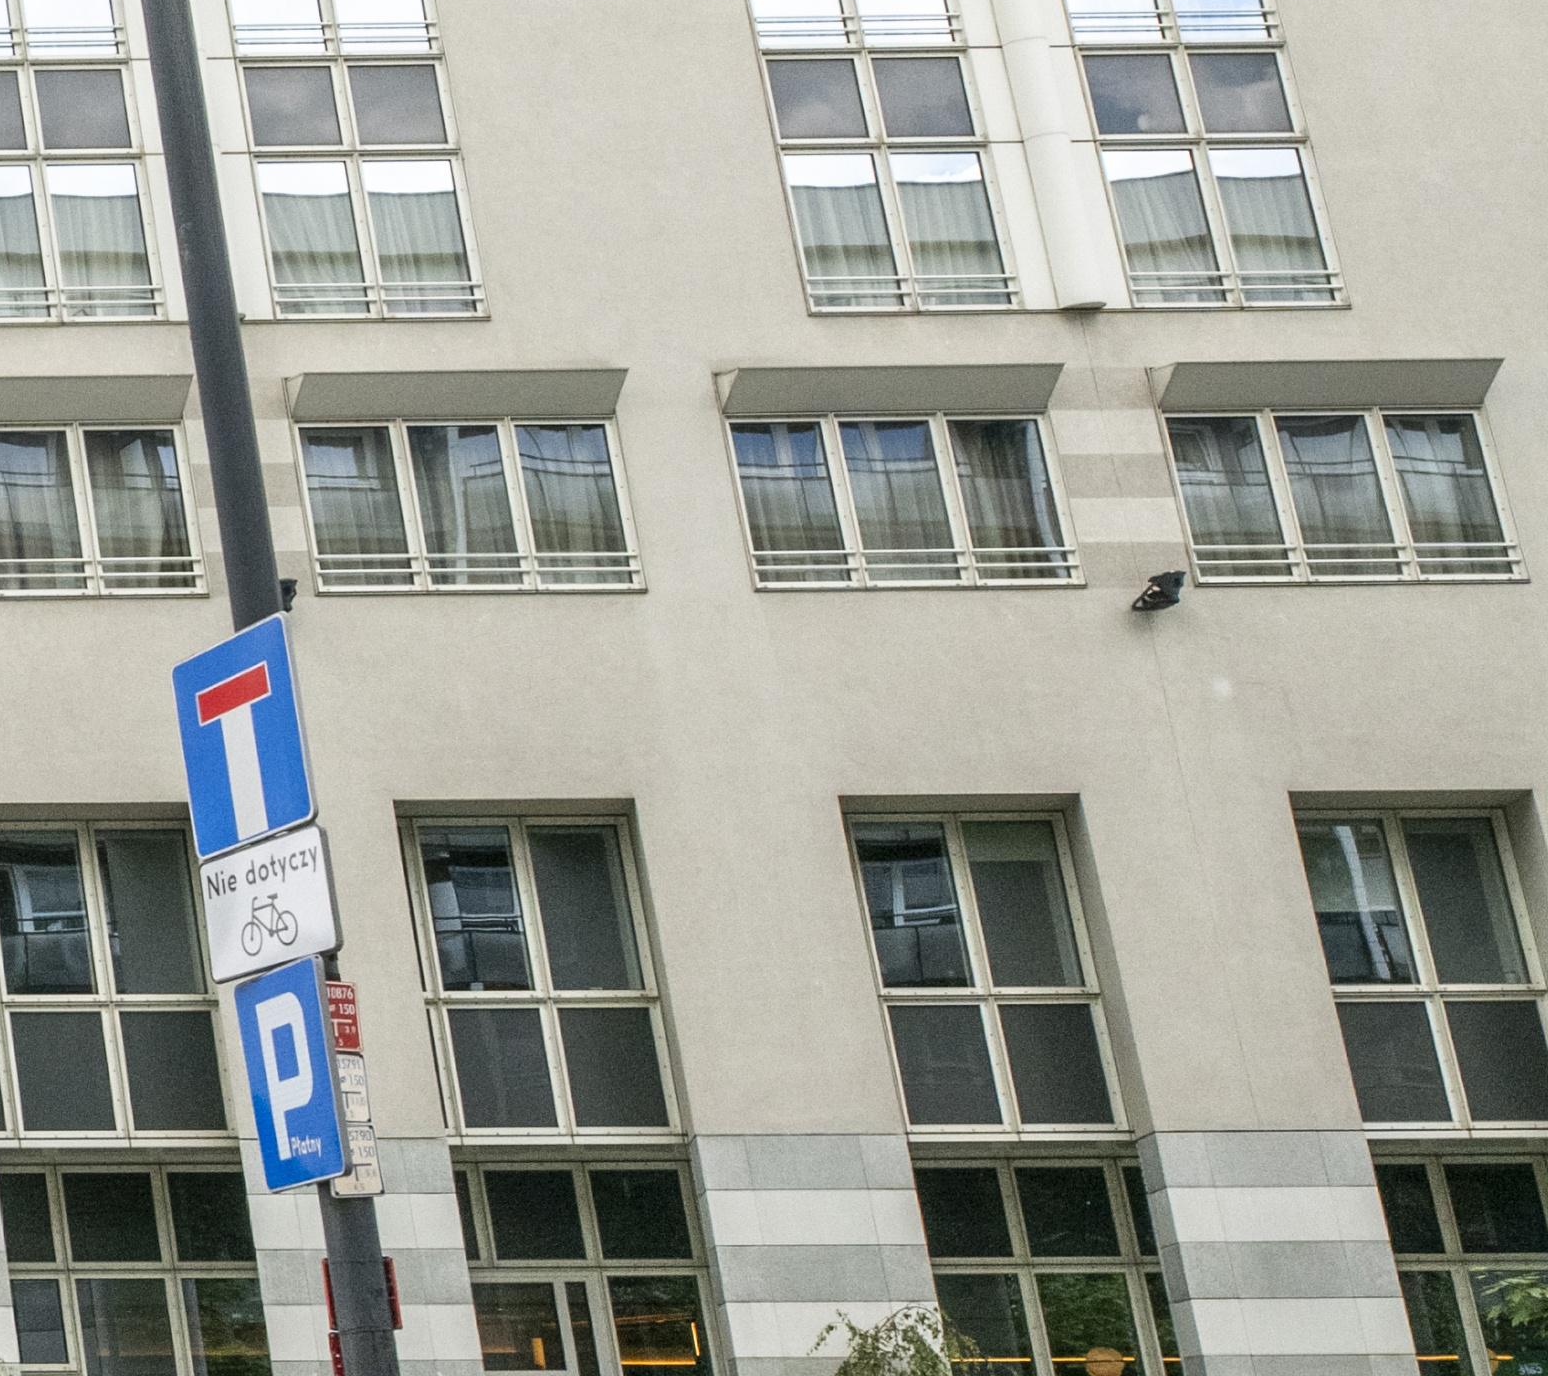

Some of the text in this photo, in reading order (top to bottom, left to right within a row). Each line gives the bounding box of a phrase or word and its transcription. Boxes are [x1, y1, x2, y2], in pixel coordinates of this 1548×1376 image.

[206, 846, 317, 899] Nie dotyczy
[338, 1003, 355, 1015] 150
[255, 991, 313, 1161] P
[349, 1074, 364, 1086] 150
[290, 1135, 322, 1158] Płatny
